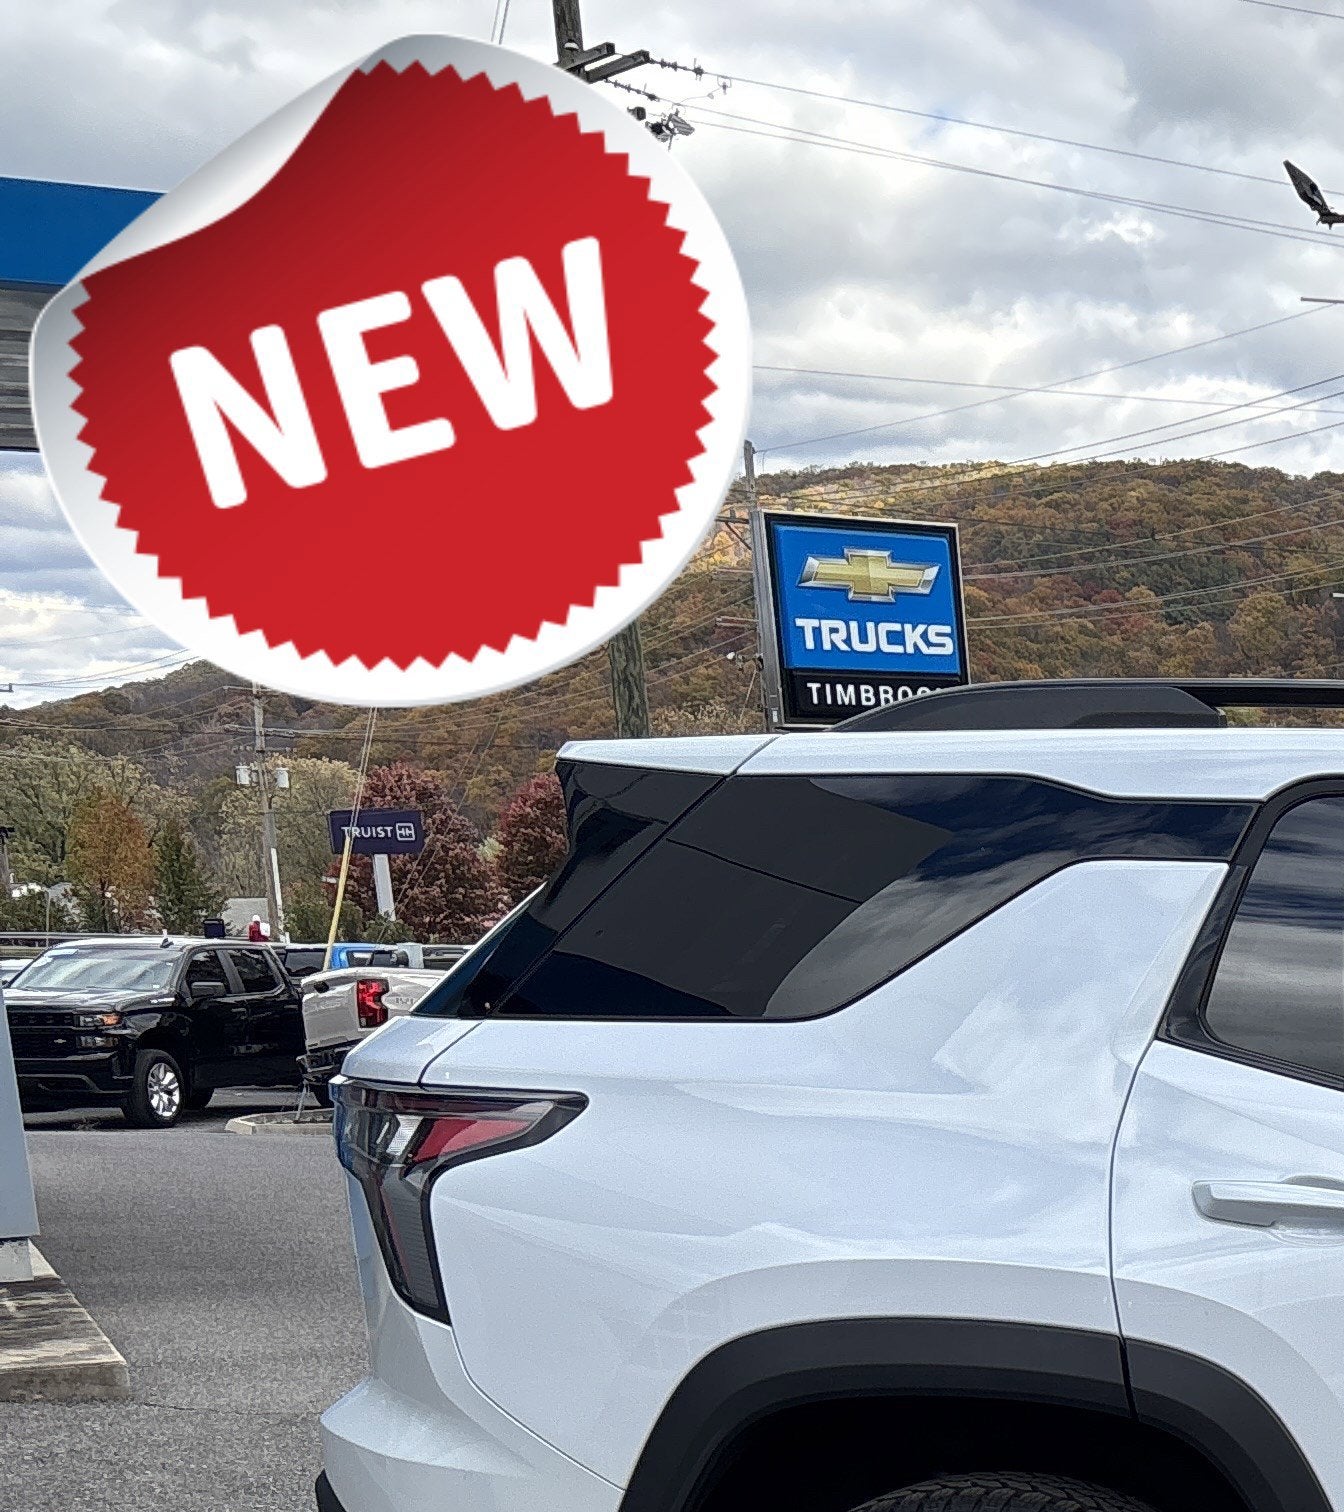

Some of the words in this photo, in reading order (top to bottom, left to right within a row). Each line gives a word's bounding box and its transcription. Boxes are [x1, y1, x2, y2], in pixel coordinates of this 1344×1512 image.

[795, 618, 954, 655] TRUCKS
[807, 683, 943, 706] TIMBRO
[341, 826, 394, 838] TRUIST
